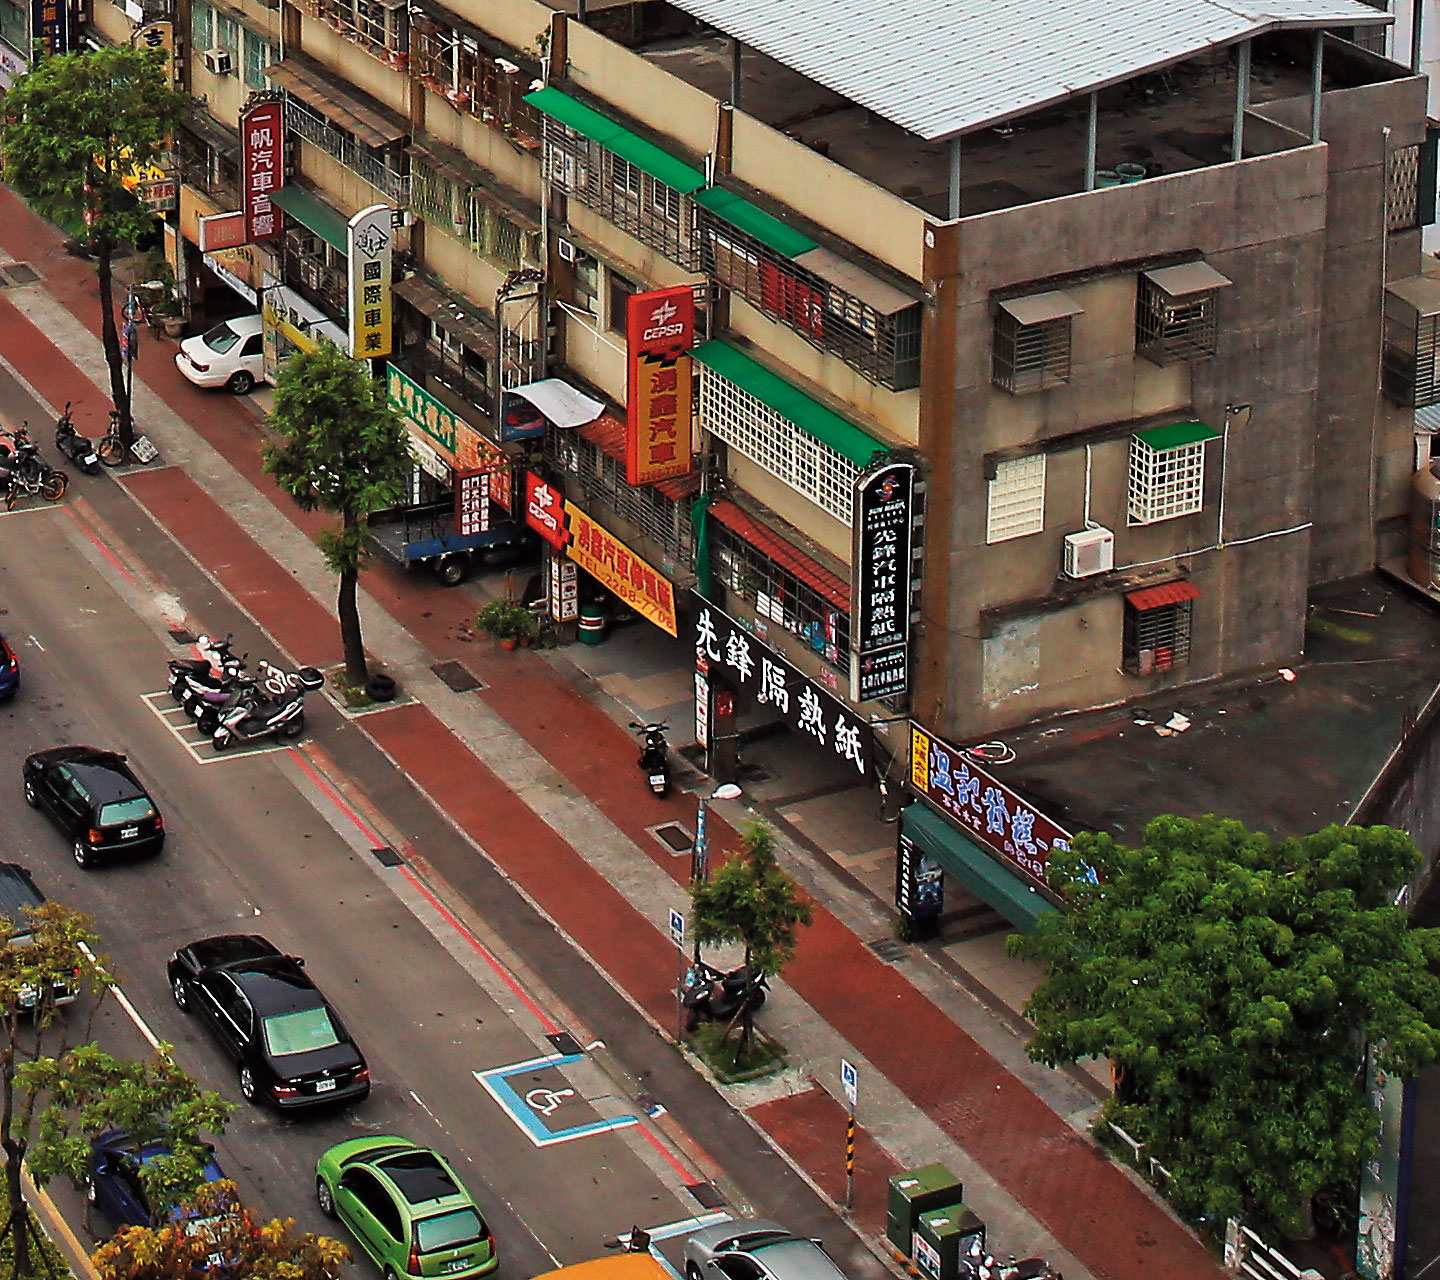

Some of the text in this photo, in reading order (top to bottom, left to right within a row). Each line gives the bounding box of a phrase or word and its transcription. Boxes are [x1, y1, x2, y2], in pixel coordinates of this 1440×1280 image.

[250, 117, 274, 237] 一帆汽車音響
[363, 262, 384, 352] 國際車業
[644, 323, 683, 340] CEPSA
[870, 529, 898, 636] 先鋒汽車隔熱紙
[695, 608, 866, 775] 先鋒隔熱紙
